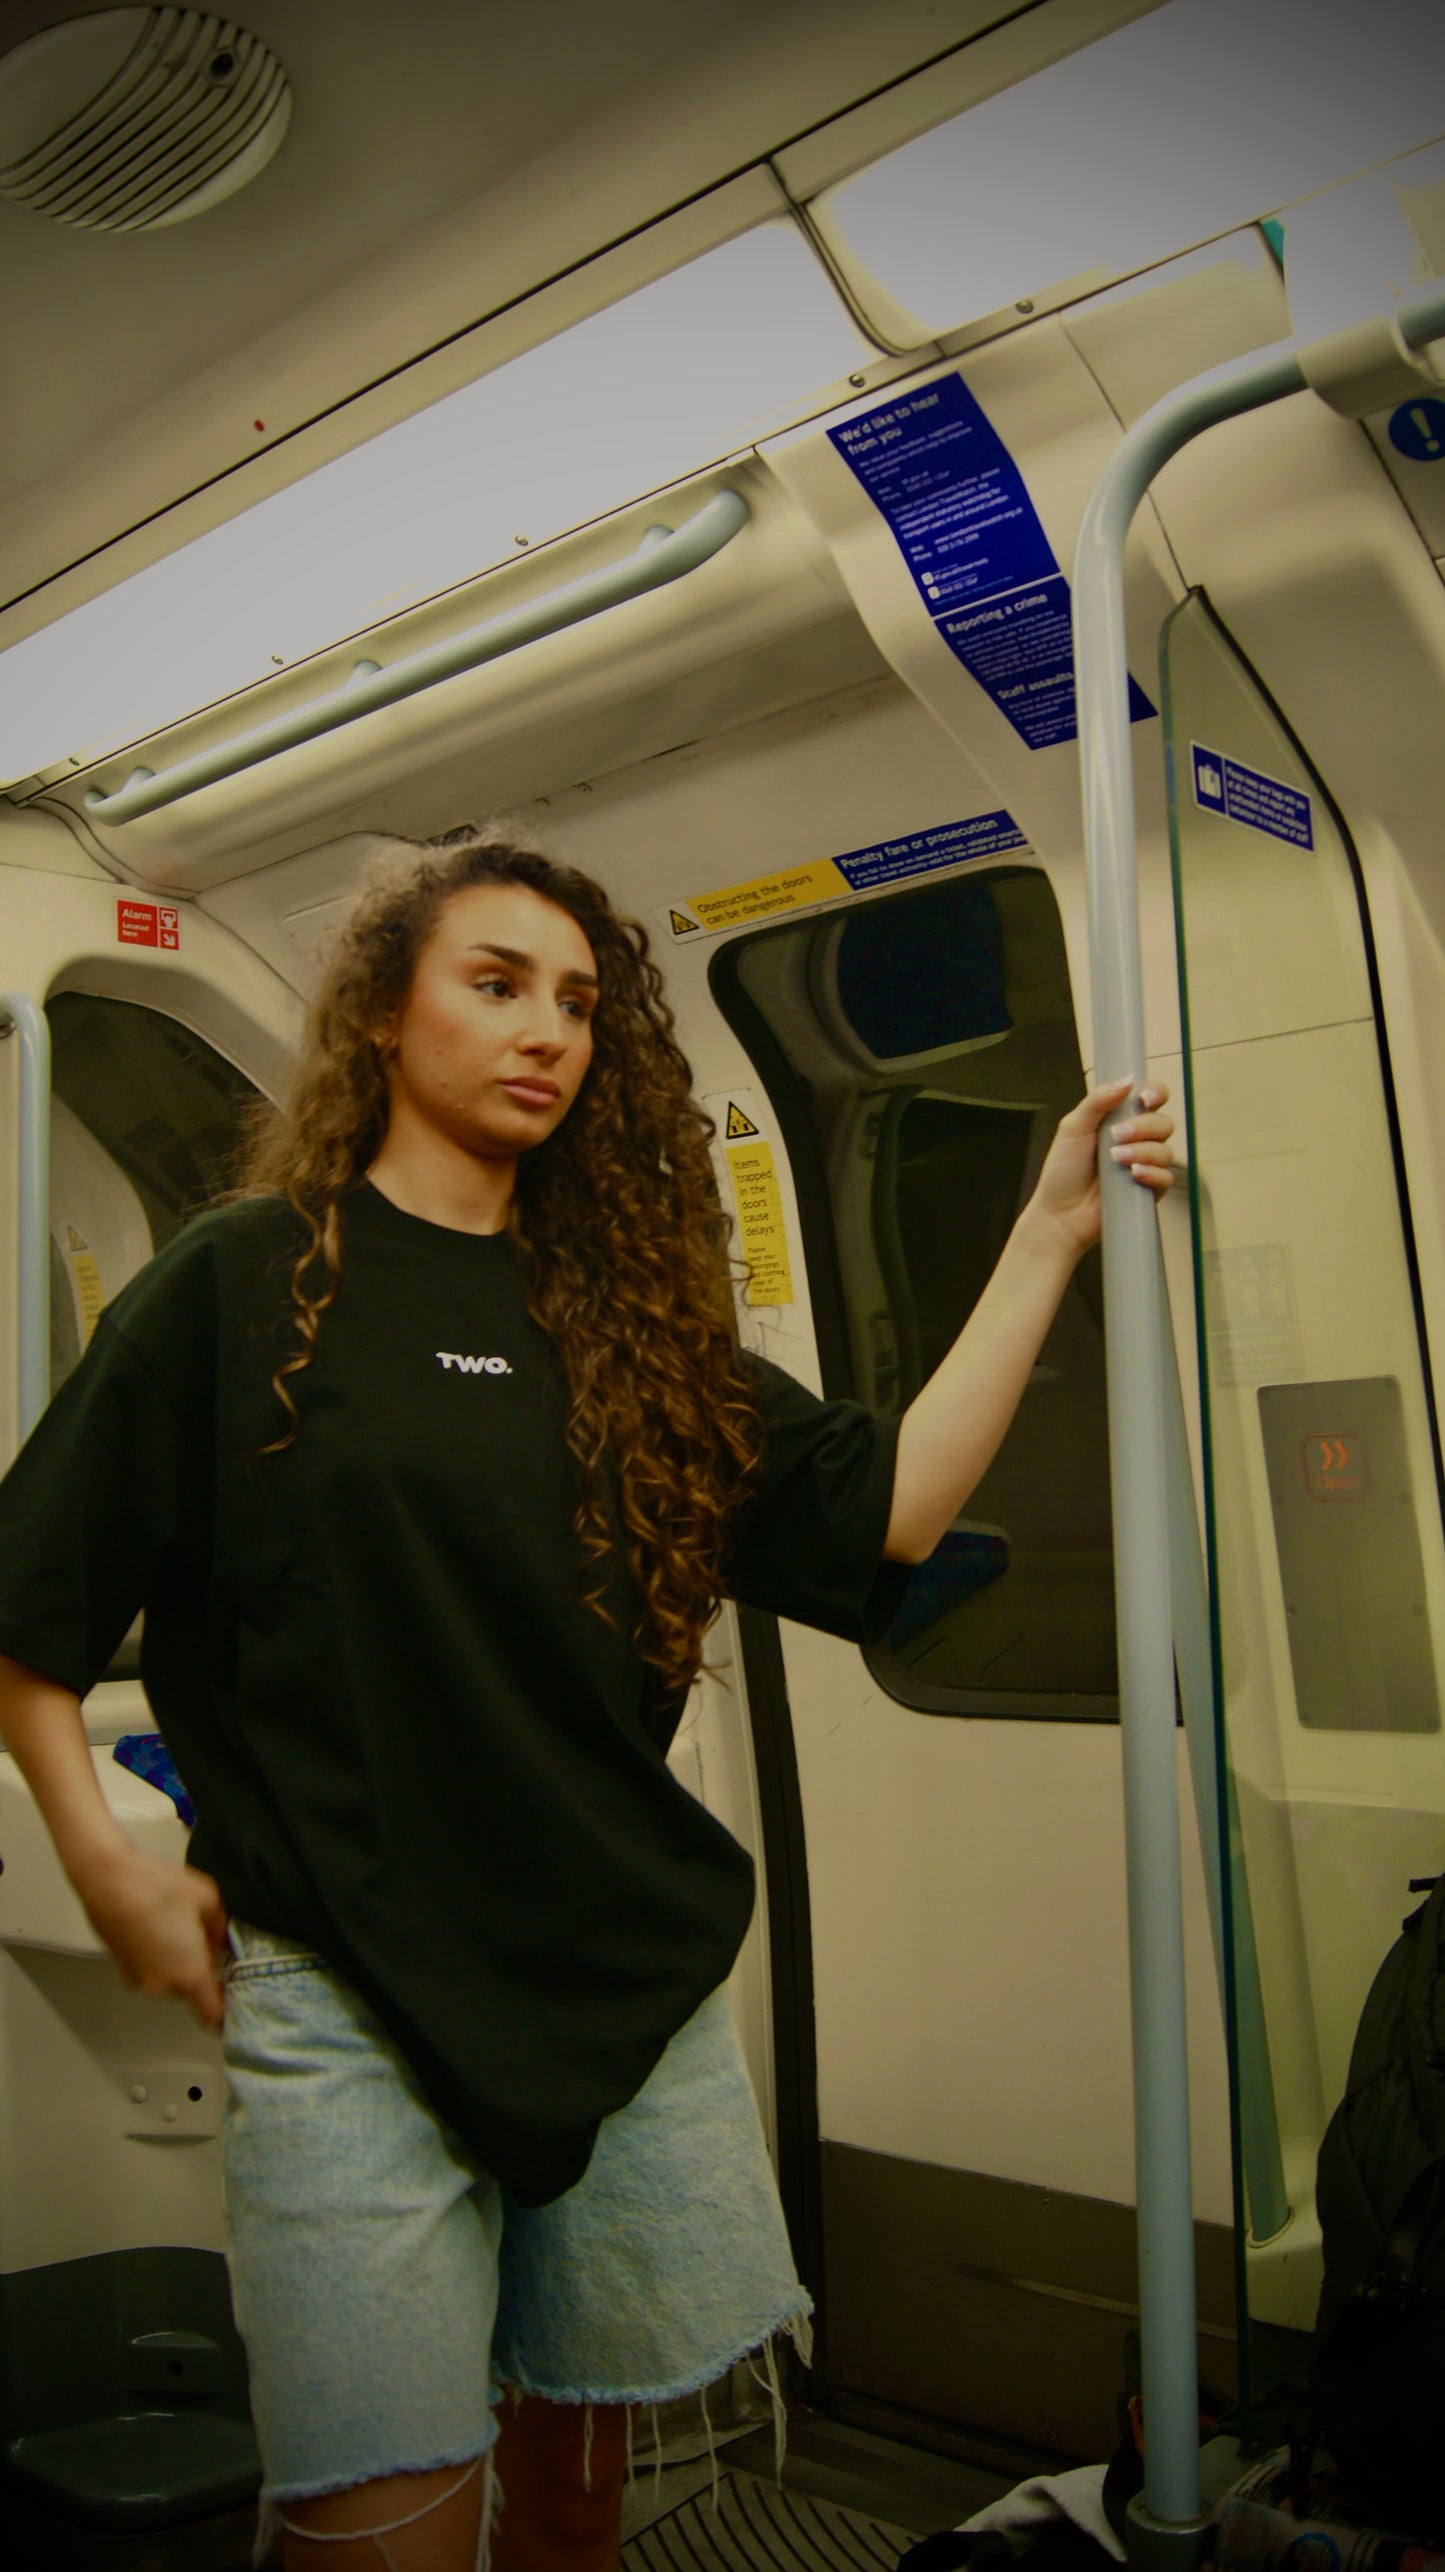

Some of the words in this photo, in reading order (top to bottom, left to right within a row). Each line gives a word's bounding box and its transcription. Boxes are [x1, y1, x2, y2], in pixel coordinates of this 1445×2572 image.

[838, 422, 871, 443] We'd
[870, 416, 895, 430] like
[894, 406, 911, 419] to
[910, 393, 939, 413] hear
[848, 438, 878, 456] from
[878, 427, 902, 445] you
[945, 608, 1004, 634] Reporting
[1004, 605, 1013, 615] a
[1014, 593, 1048, 612] crime
[997, 684, 1026, 700] Staff
[1028, 671, 1074, 692] assaults
[840, 851, 884, 869] Penalty
[884, 844, 909, 857] fare
[910, 839, 924, 849] or
[925, 819, 998, 847] prosecution
[696, 890, 761, 913] Obstructing
[760, 885, 780, 896] the
[781, 875, 813, 890] doors
[122, 908, 152, 921] Alarm
[706, 914, 726, 925] can
[725, 909, 741, 919] be
[742, 894, 796, 914] dangerous
[733, 1159, 760, 1170] Items
[736, 1169, 772, 1183] trapped
[740, 1186, 748, 1196] in
[750, 1185, 766, 1195] the
[741, 1199, 767, 1210] doors
[743, 1212, 770, 1223] cause
[745, 1225, 775, 1237] delays
[435, 1351, 513, 1374] TWO.
